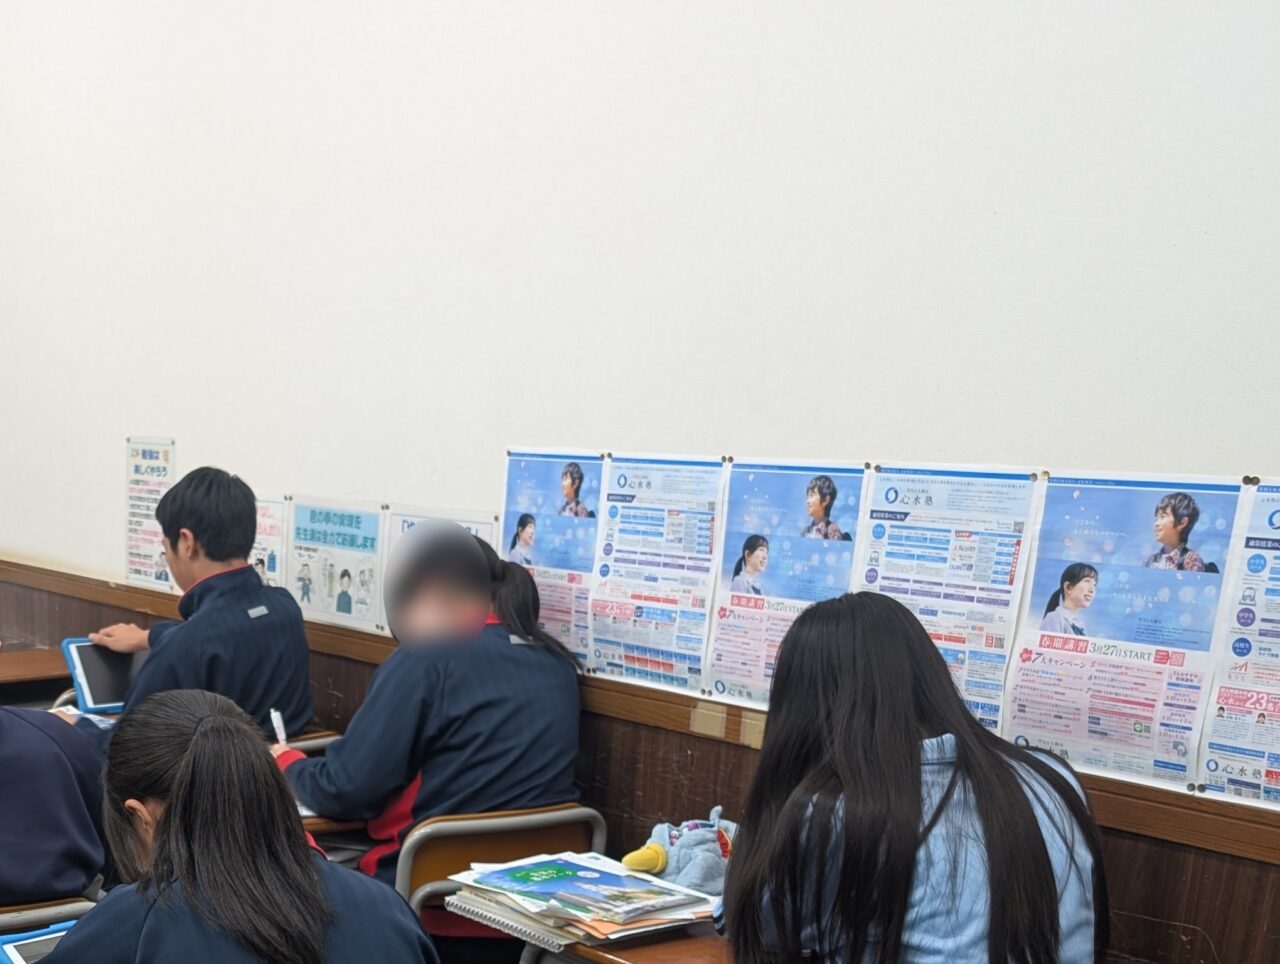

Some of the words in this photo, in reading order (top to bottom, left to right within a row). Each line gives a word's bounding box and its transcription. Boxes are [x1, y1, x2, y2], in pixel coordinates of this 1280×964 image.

[899, 495, 934, 506] 心水塾
[1032, 652, 1087, 669] 7大キャンペーン
[1245, 691, 1268, 710] 23
[1221, 763, 1263, 779] 心水塾
